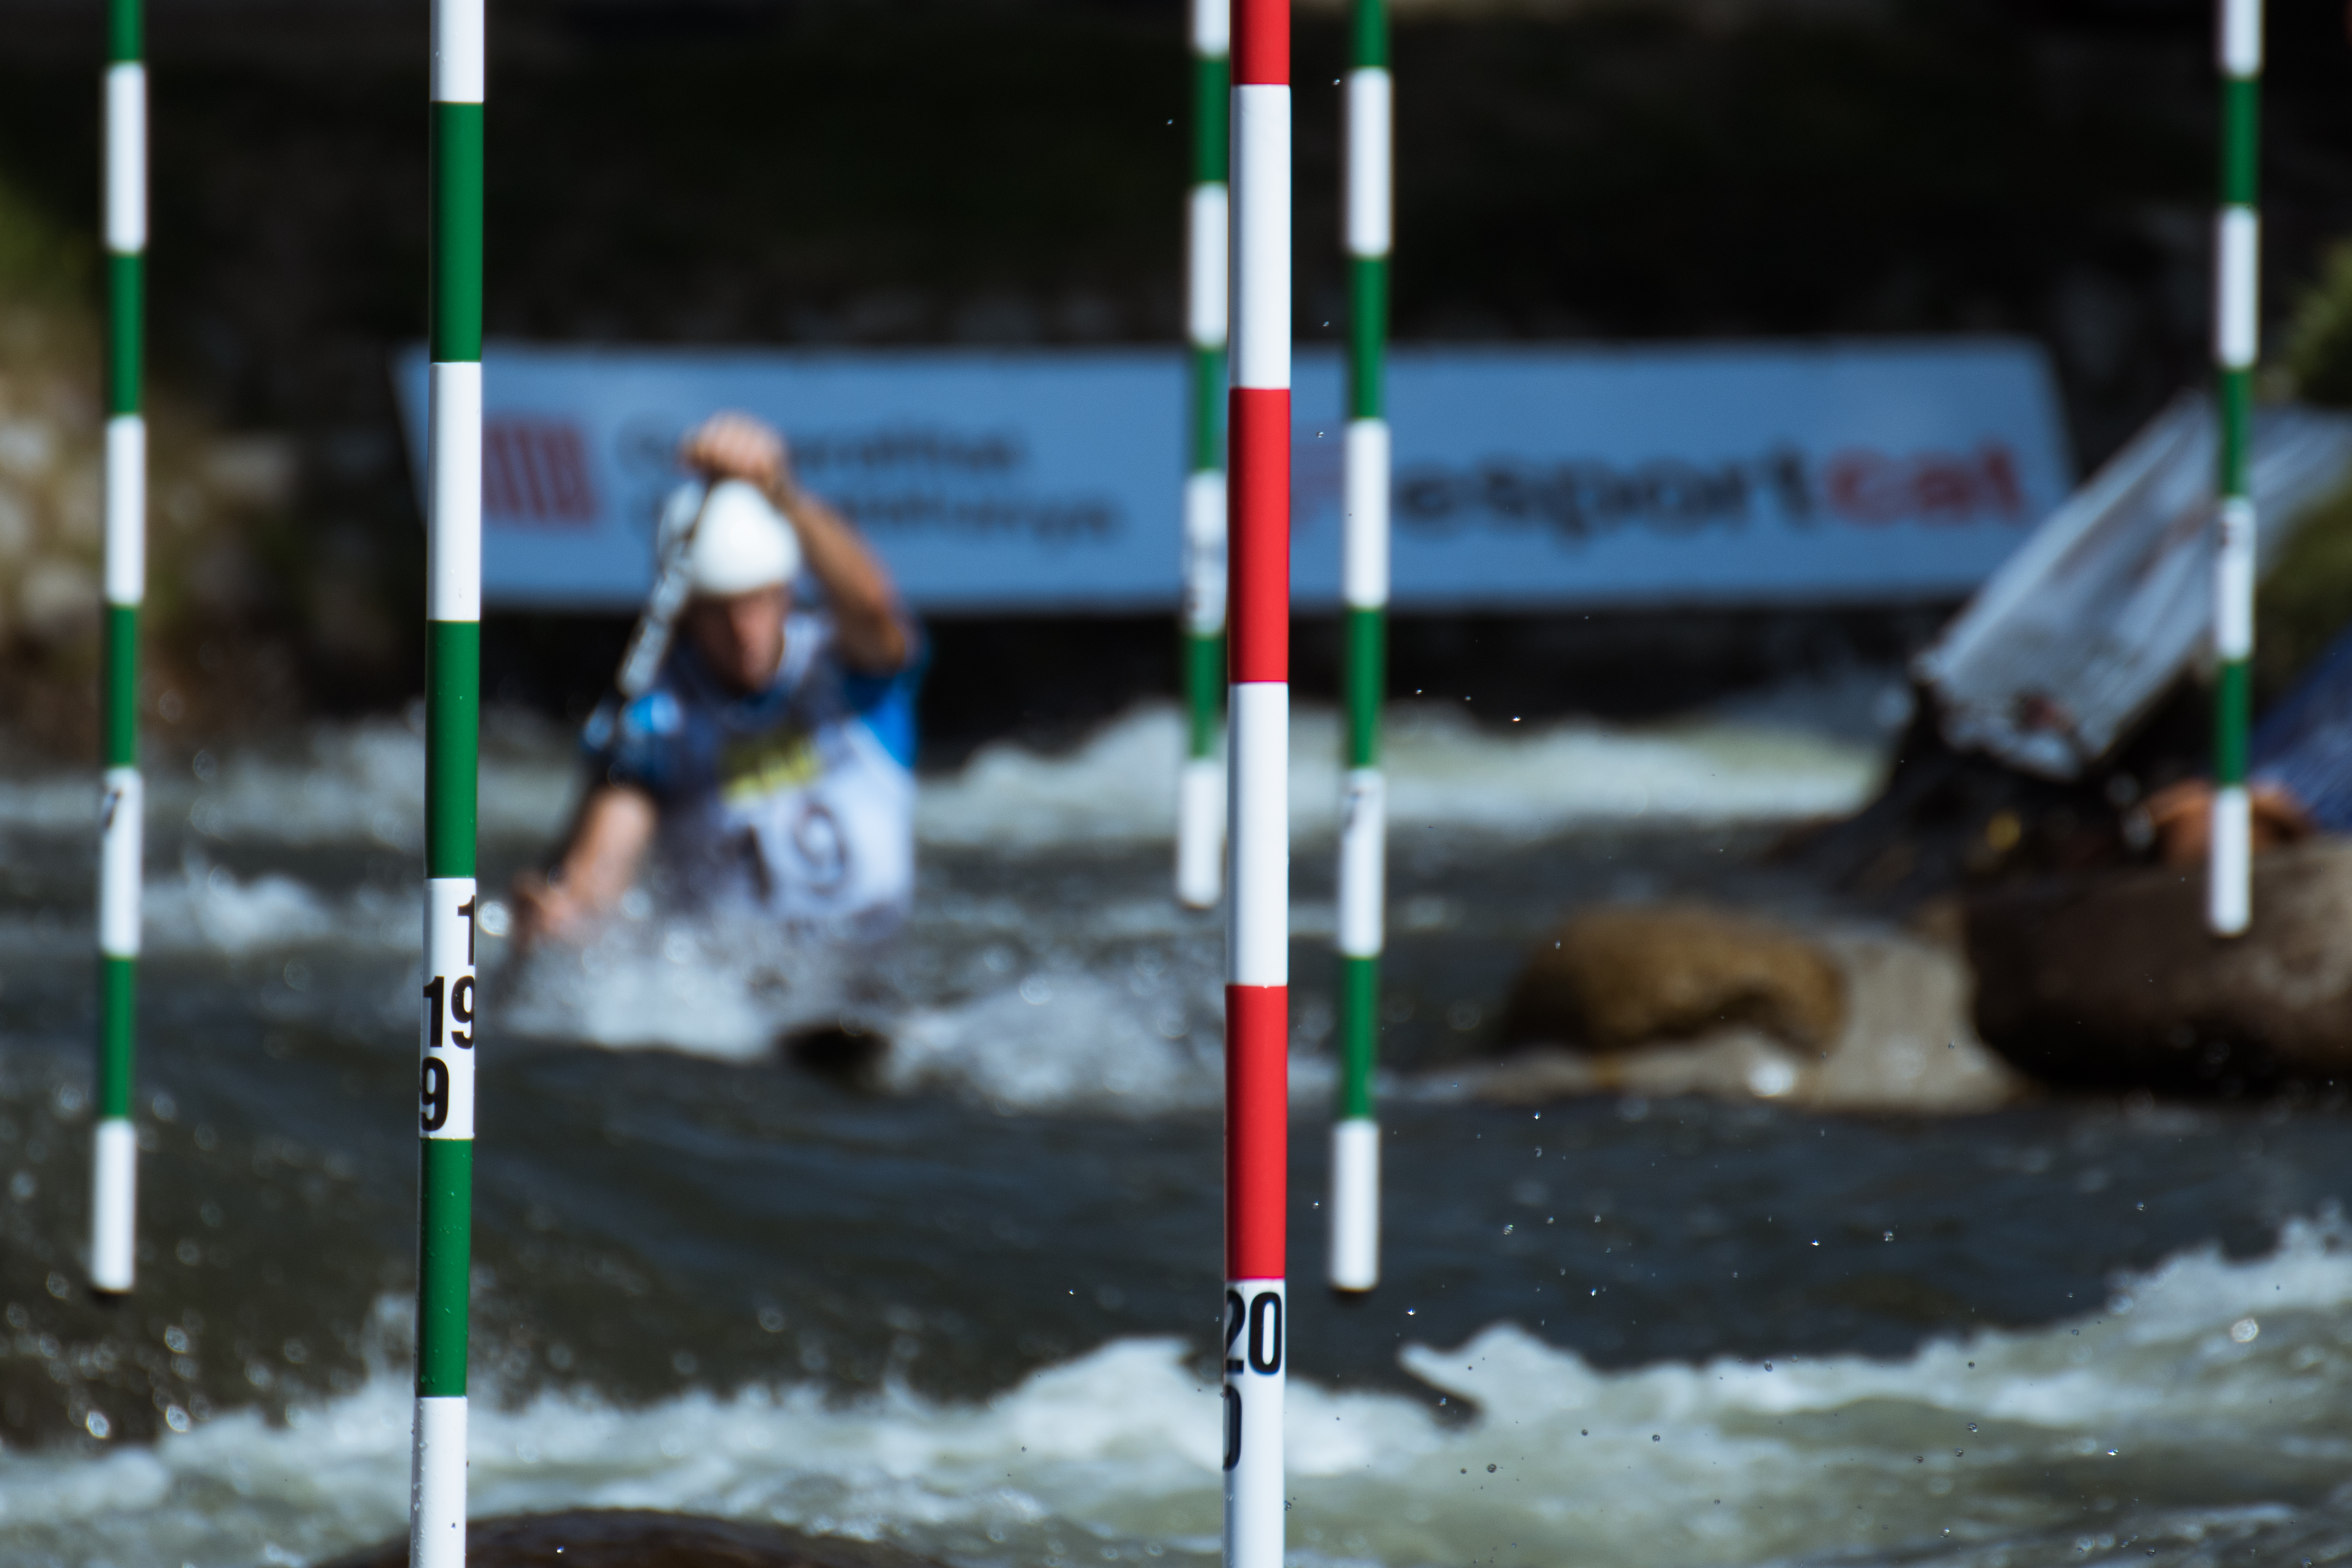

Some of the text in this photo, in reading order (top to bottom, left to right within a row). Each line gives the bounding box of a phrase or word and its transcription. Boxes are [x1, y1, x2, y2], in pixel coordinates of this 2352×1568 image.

[423, 975, 475, 1049] 19
[420, 1056, 449, 1131] 9
[1225, 1289, 1282, 1376] 20
